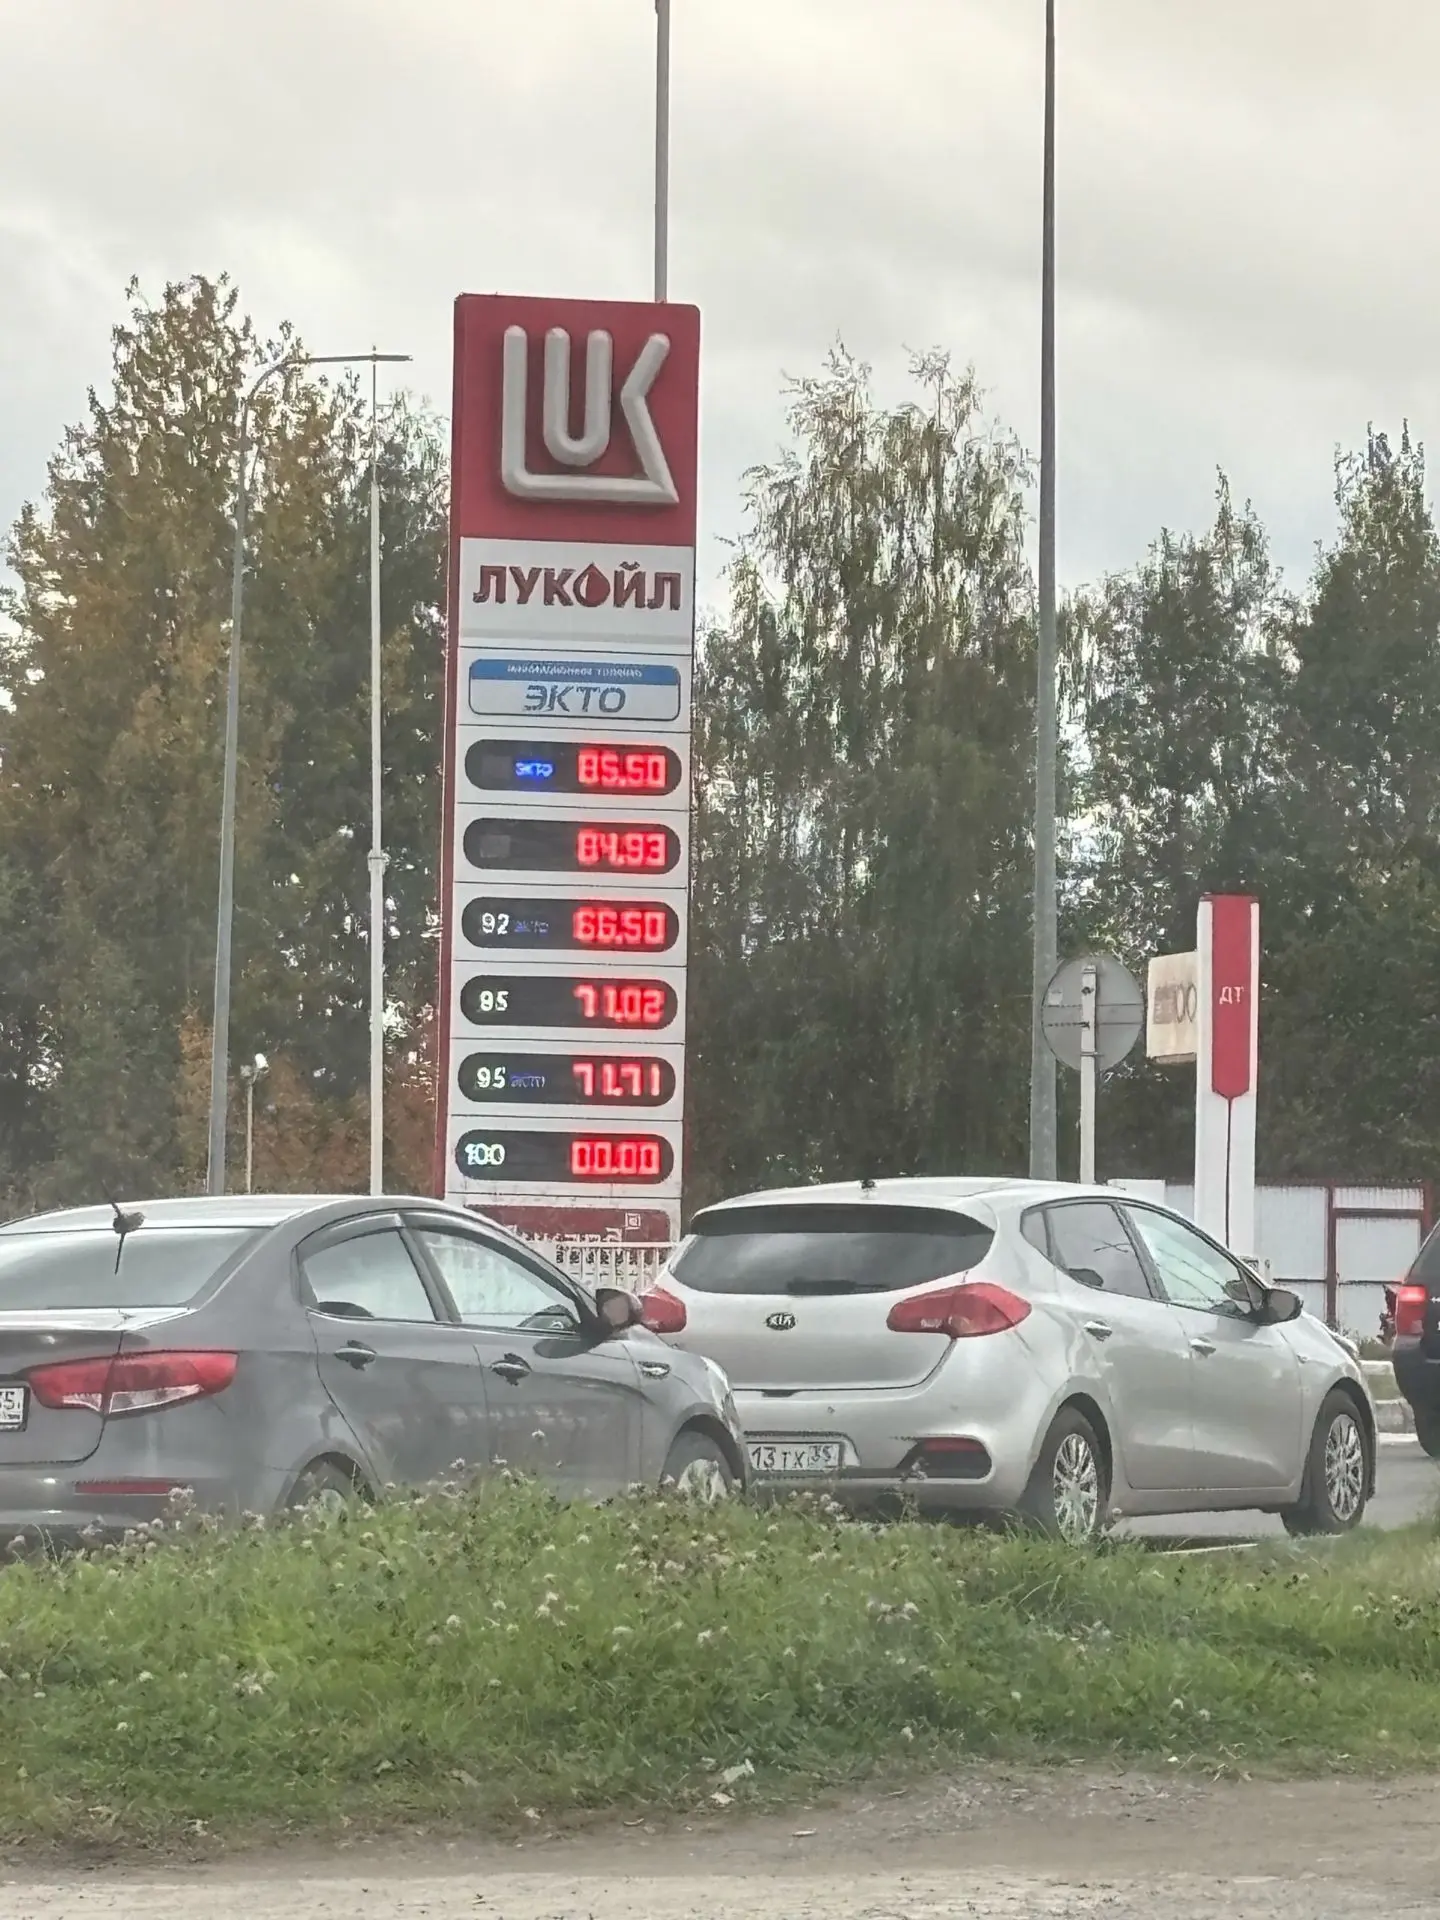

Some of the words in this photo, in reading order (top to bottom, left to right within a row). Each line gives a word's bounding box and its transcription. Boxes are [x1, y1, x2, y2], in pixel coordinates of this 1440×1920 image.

[472, 561, 682, 611] ЛУКОЙЛ
[523, 684, 627, 713] ЭКТО
[578, 749, 667, 788] 85.50
[481, 912, 510, 935] 92
[573, 908, 666, 944] 66.50
[573, 984, 665, 1023] 71.02
[1219, 985, 1245, 1005] ДТ
[477, 1066, 506, 1089] 95
[572, 1063, 660, 1097] 71.71
[464, 1142, 506, 1166] 100
[571, 1141, 660, 1175] 00.00
[0, 1391, 15, 1410] 5
